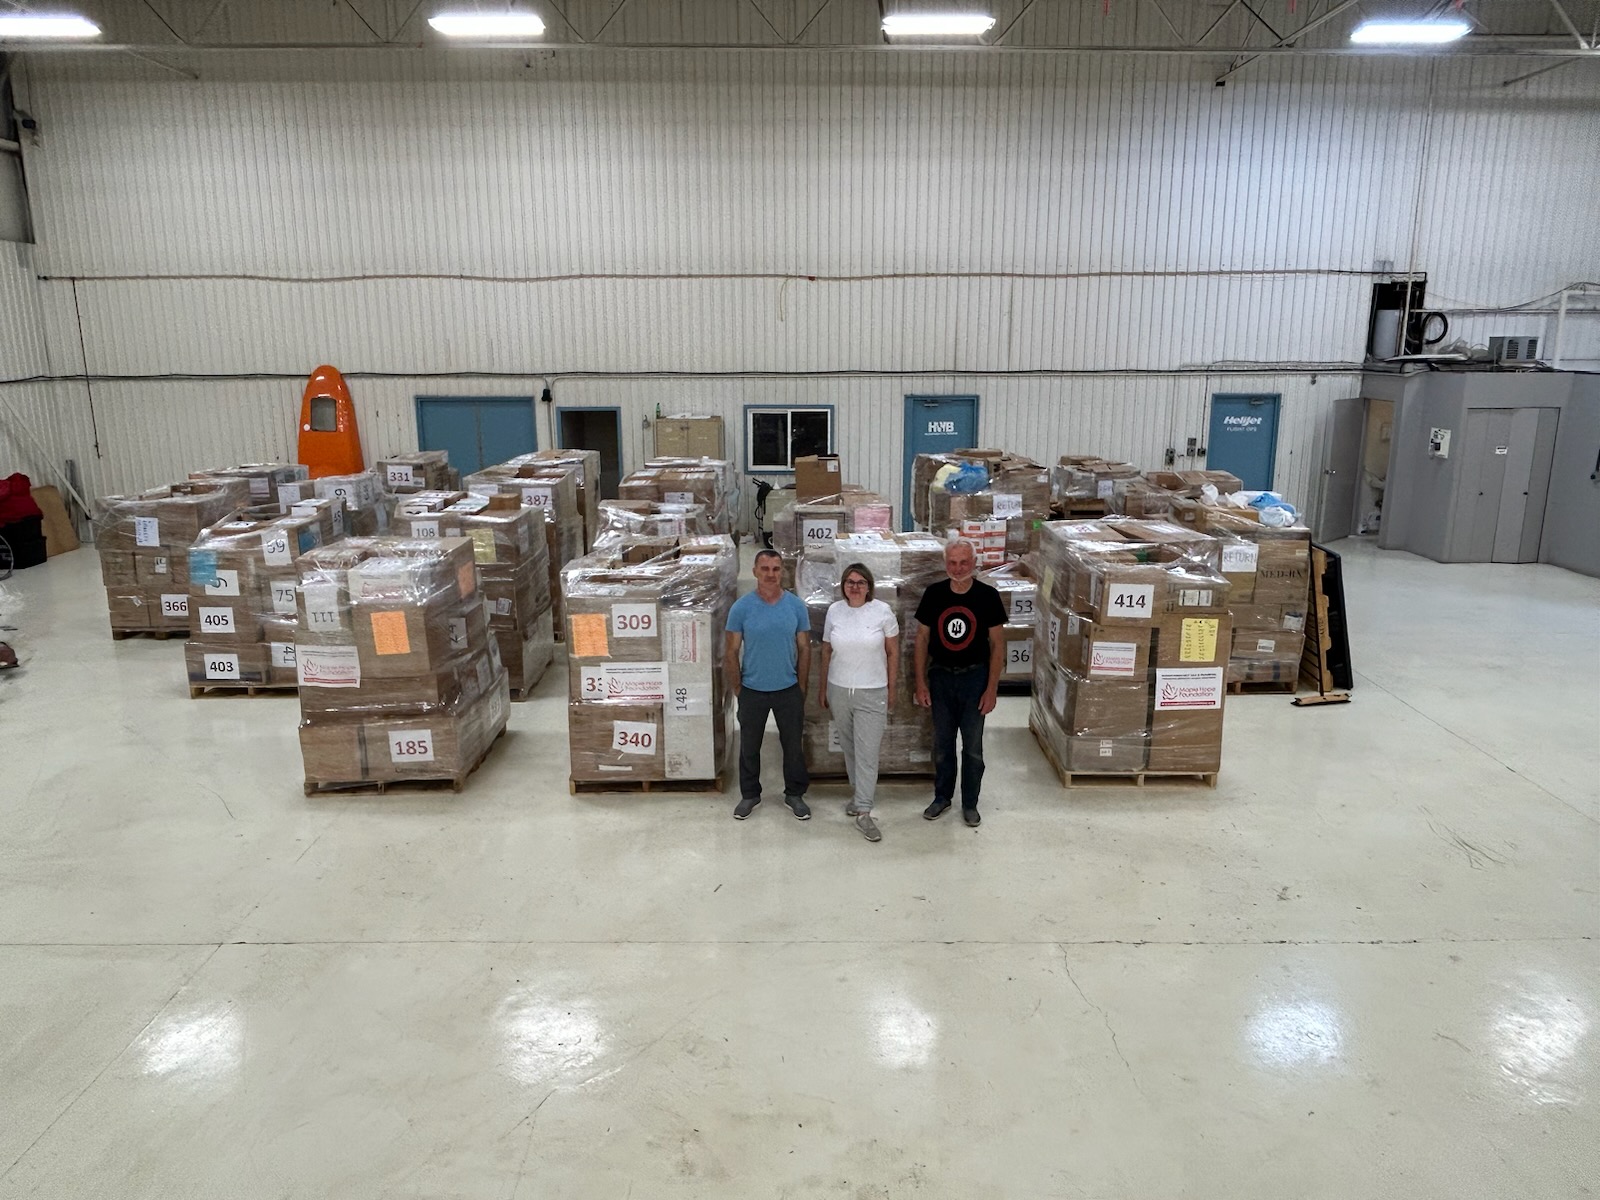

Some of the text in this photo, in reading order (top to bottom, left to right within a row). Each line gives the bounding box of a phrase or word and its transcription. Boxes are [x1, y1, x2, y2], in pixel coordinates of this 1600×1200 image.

[390, 471, 410, 482] 331
[526, 494, 549, 506] 387
[416, 527, 436, 538] 108
[807, 527, 833, 540] 402
[1224, 551, 1257, 564] RETURN
[275, 589, 294, 602] 75
[1114, 593, 1147, 608] 414
[164, 600, 187, 612] 366
[1015, 600, 1033, 613] 53
[204, 614, 229, 626] 405
[617, 614, 652, 630] 309
[283, 645, 296, 664] 41
[1011, 649, 1030, 663] 36
[210, 661, 234, 672] 403
[676, 687, 688, 711] 148
[617, 731, 652, 748] 340
[395, 740, 429, 755] 185
